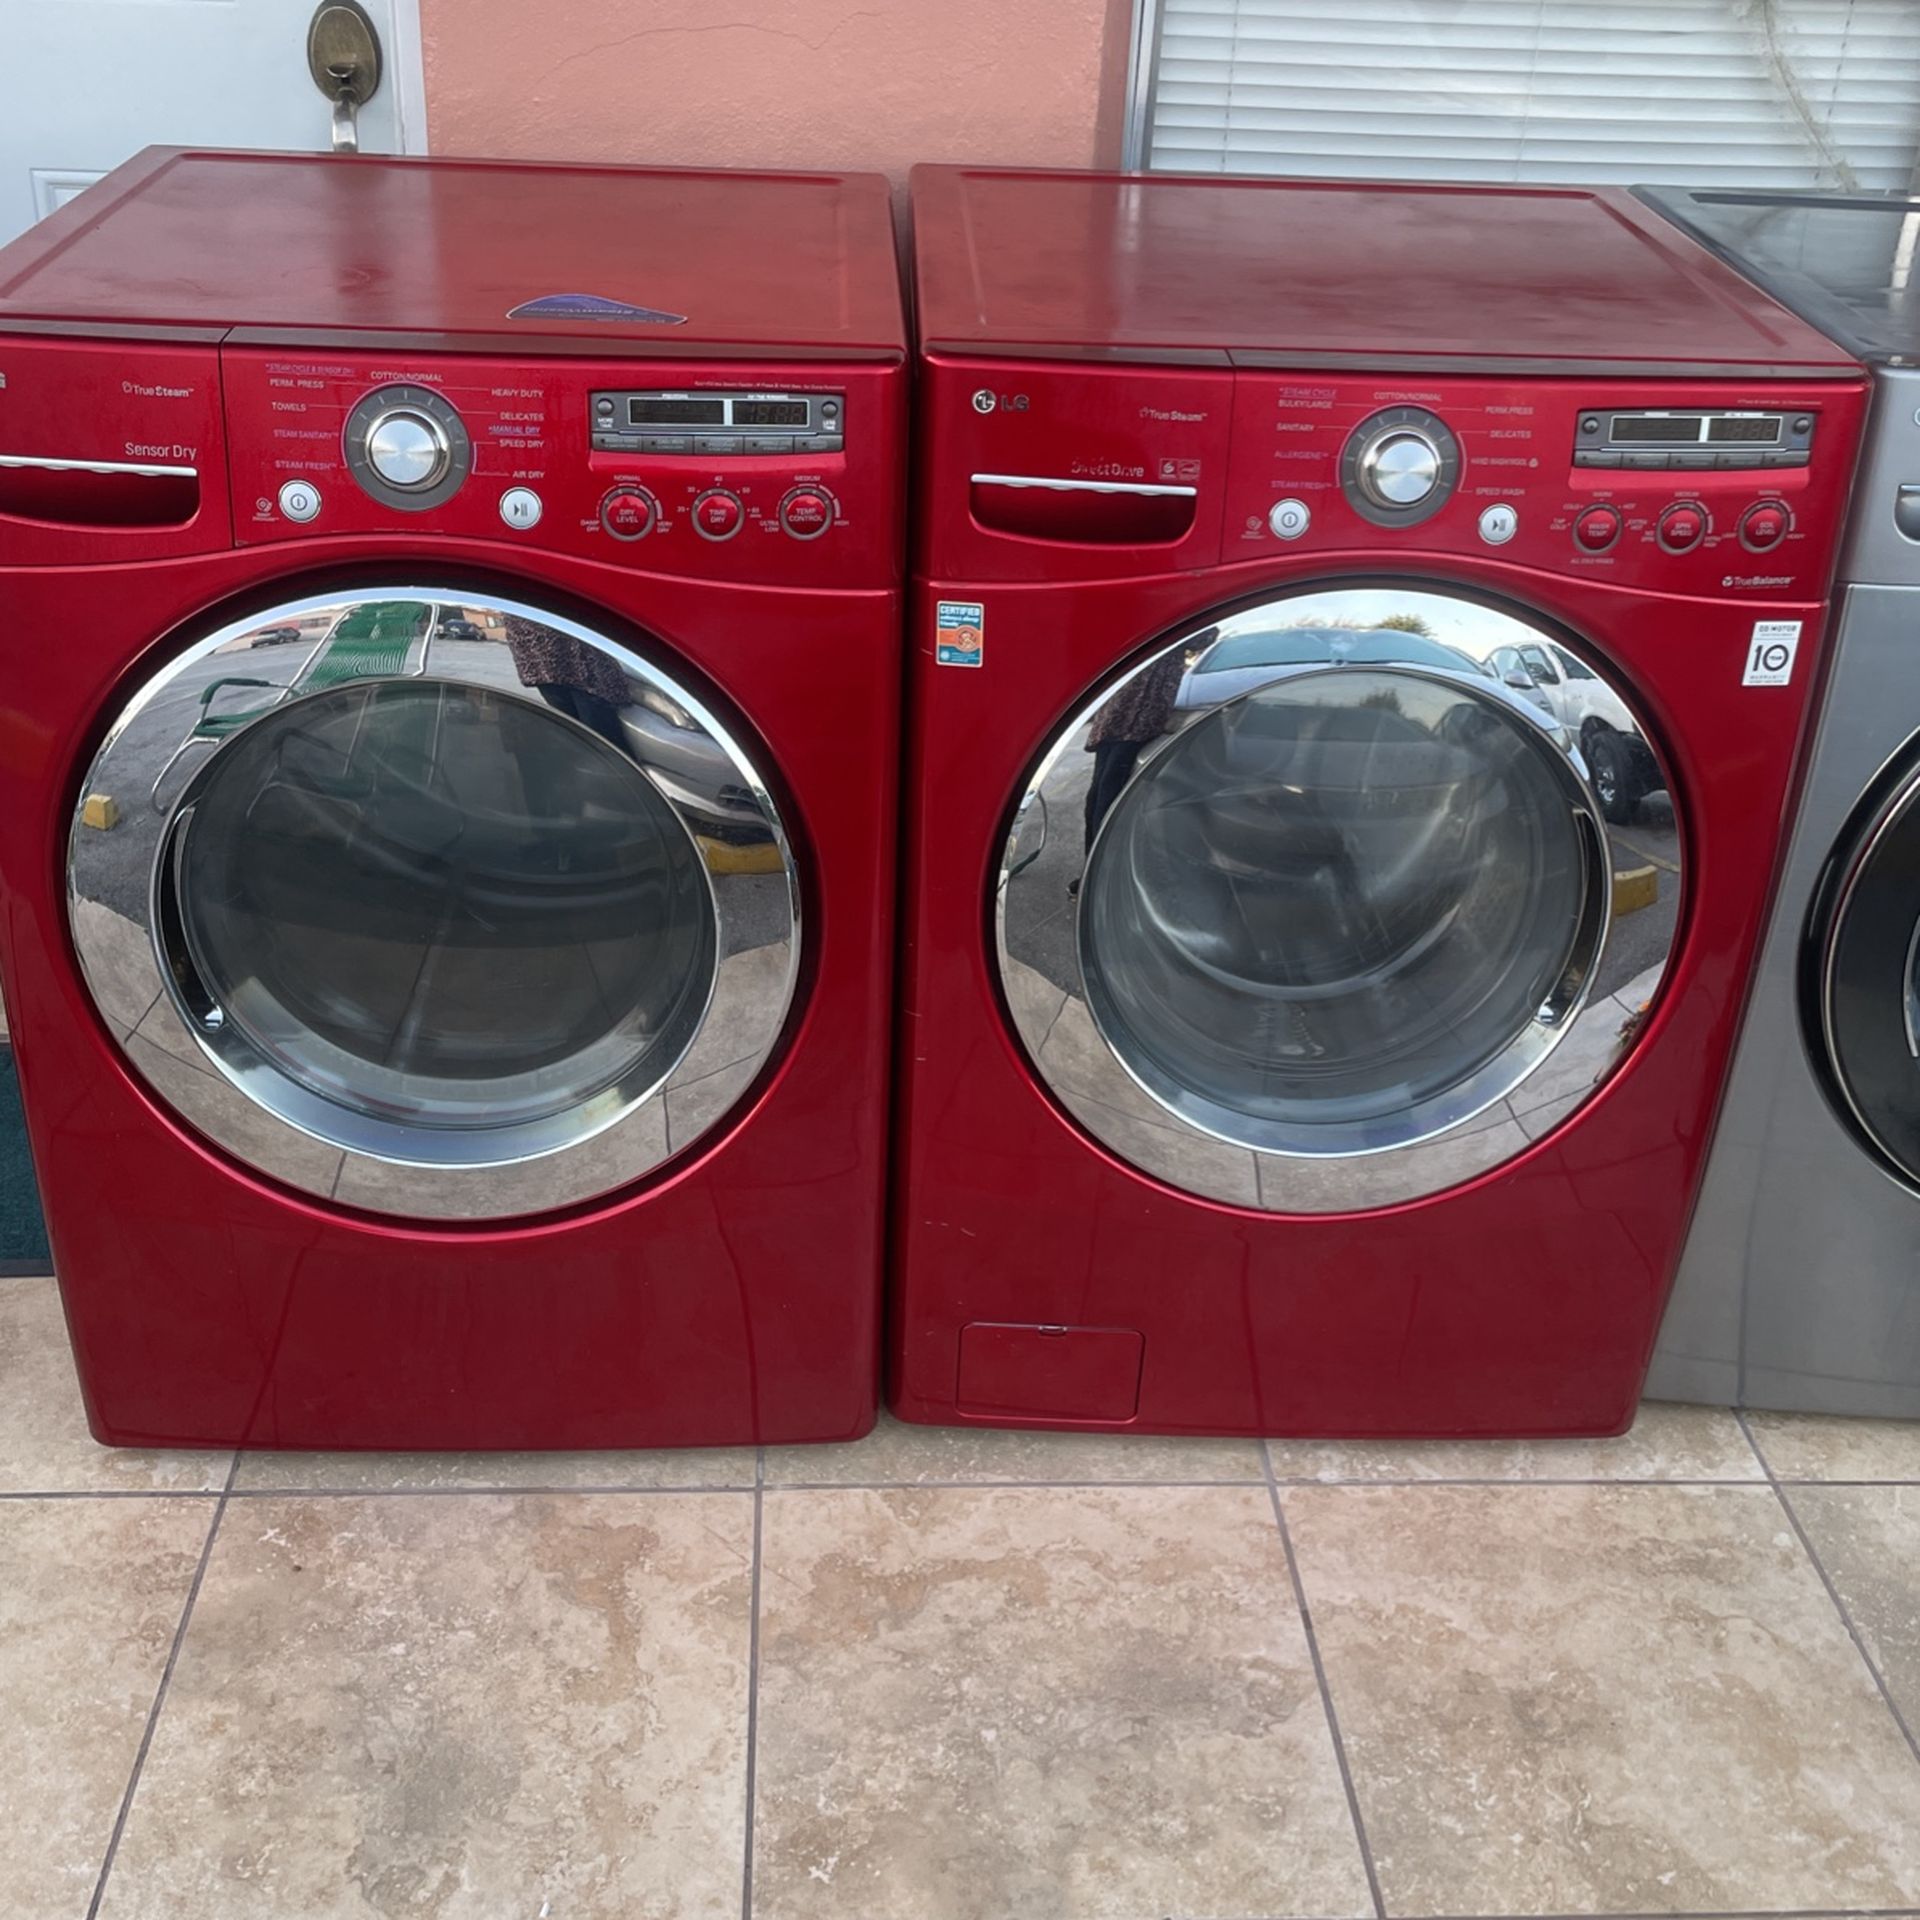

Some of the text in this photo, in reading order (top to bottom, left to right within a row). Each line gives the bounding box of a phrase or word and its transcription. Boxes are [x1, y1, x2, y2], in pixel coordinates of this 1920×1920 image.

[370, 370, 444, 383] COTTON/NORMAL
[297, 379, 325, 390] PRESS
[491, 388, 545, 399] HEAVY DUTY
[271, 401, 307, 412] TOWELS
[500, 411, 545, 422] DELICATES
[273, 428, 299, 438] STEAM
[525, 426, 541, 435] DRY
[1489, 430, 1532, 439] DELICATES
[499, 438, 545, 449] SPEED DRY
[124, 441, 198, 462] Sensor Dry
[512, 469, 546, 480] AIR DRY
[613, 474, 642, 482] NORMAL
[619, 508, 636, 516] DRY
[708, 508, 727, 516] TIME
[615, 515, 639, 524] LEVEL
[710, 516, 726, 524] DRY
[788, 515, 824, 523] CONTROL
[940, 605, 981, 617] CERTIFIED
[1751, 643, 1790, 672] 10
